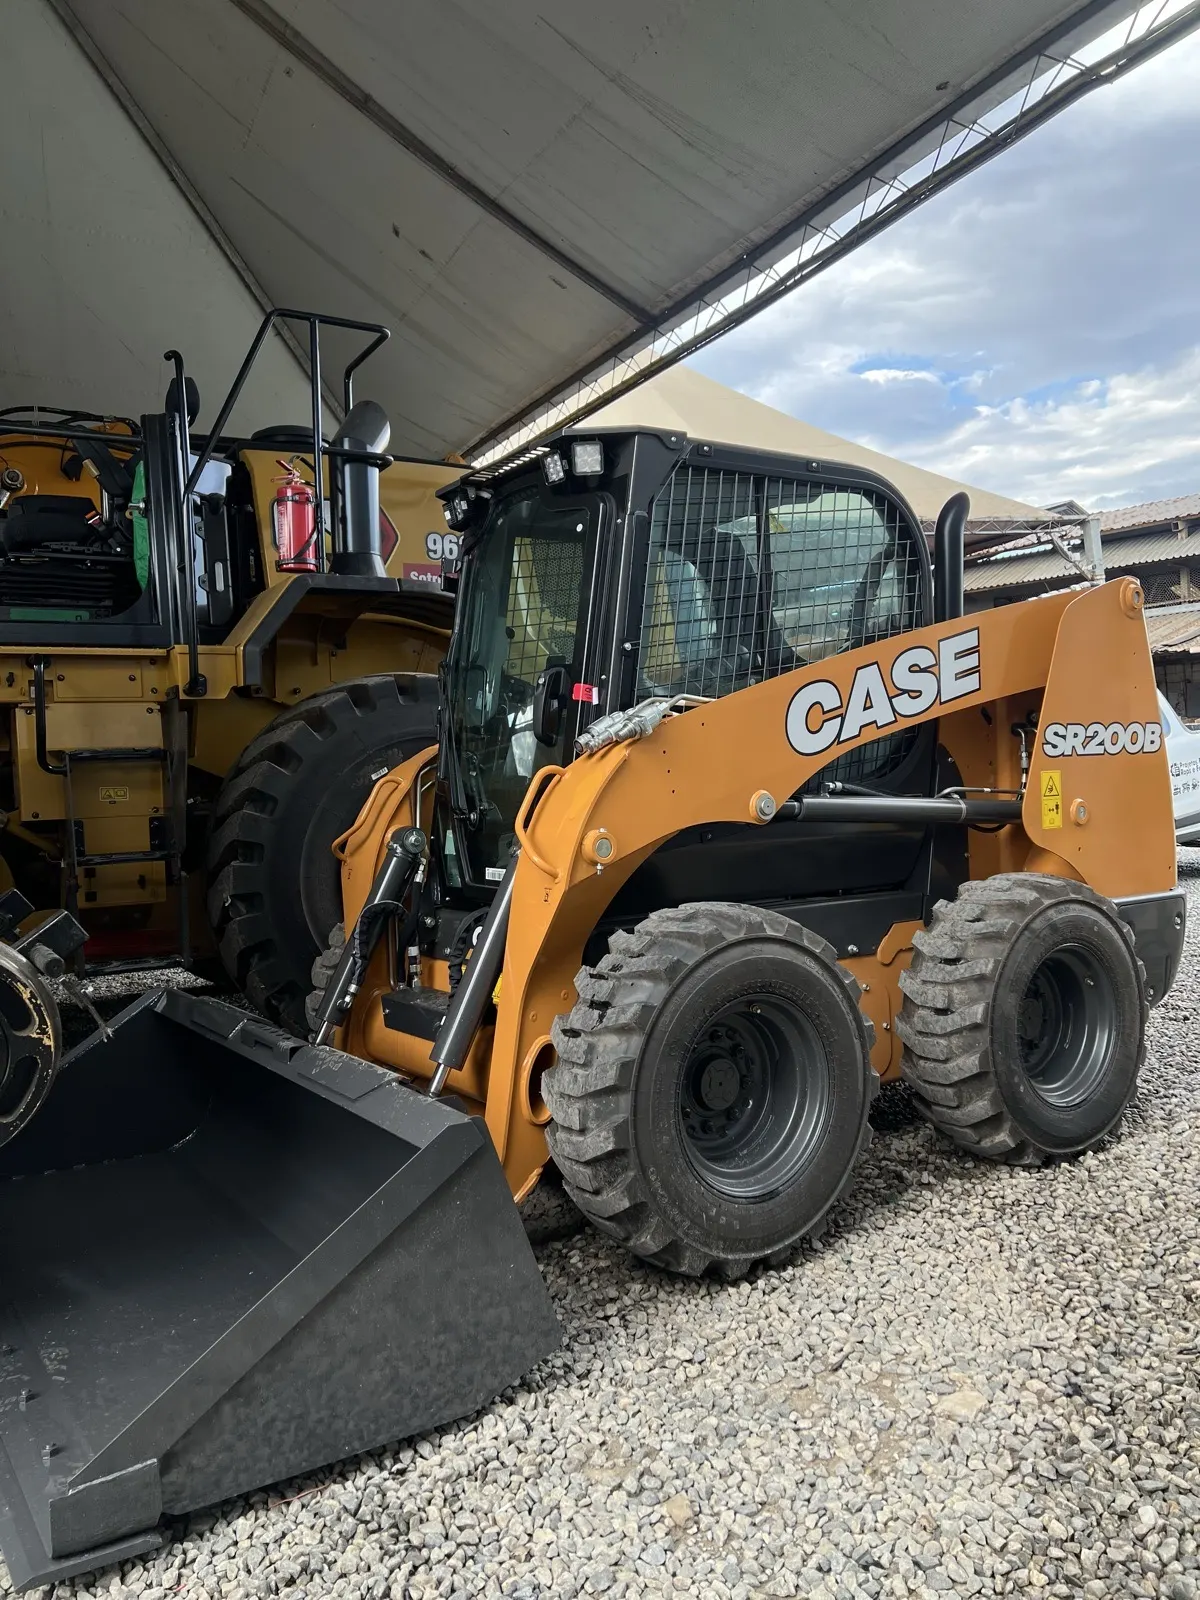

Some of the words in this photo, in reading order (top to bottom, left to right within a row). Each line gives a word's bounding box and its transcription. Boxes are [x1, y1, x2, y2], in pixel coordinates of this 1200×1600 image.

[426, 532, 464, 560] 96
[785, 626, 981, 756] CASE
[1042, 721, 1162, 758] SR200B
